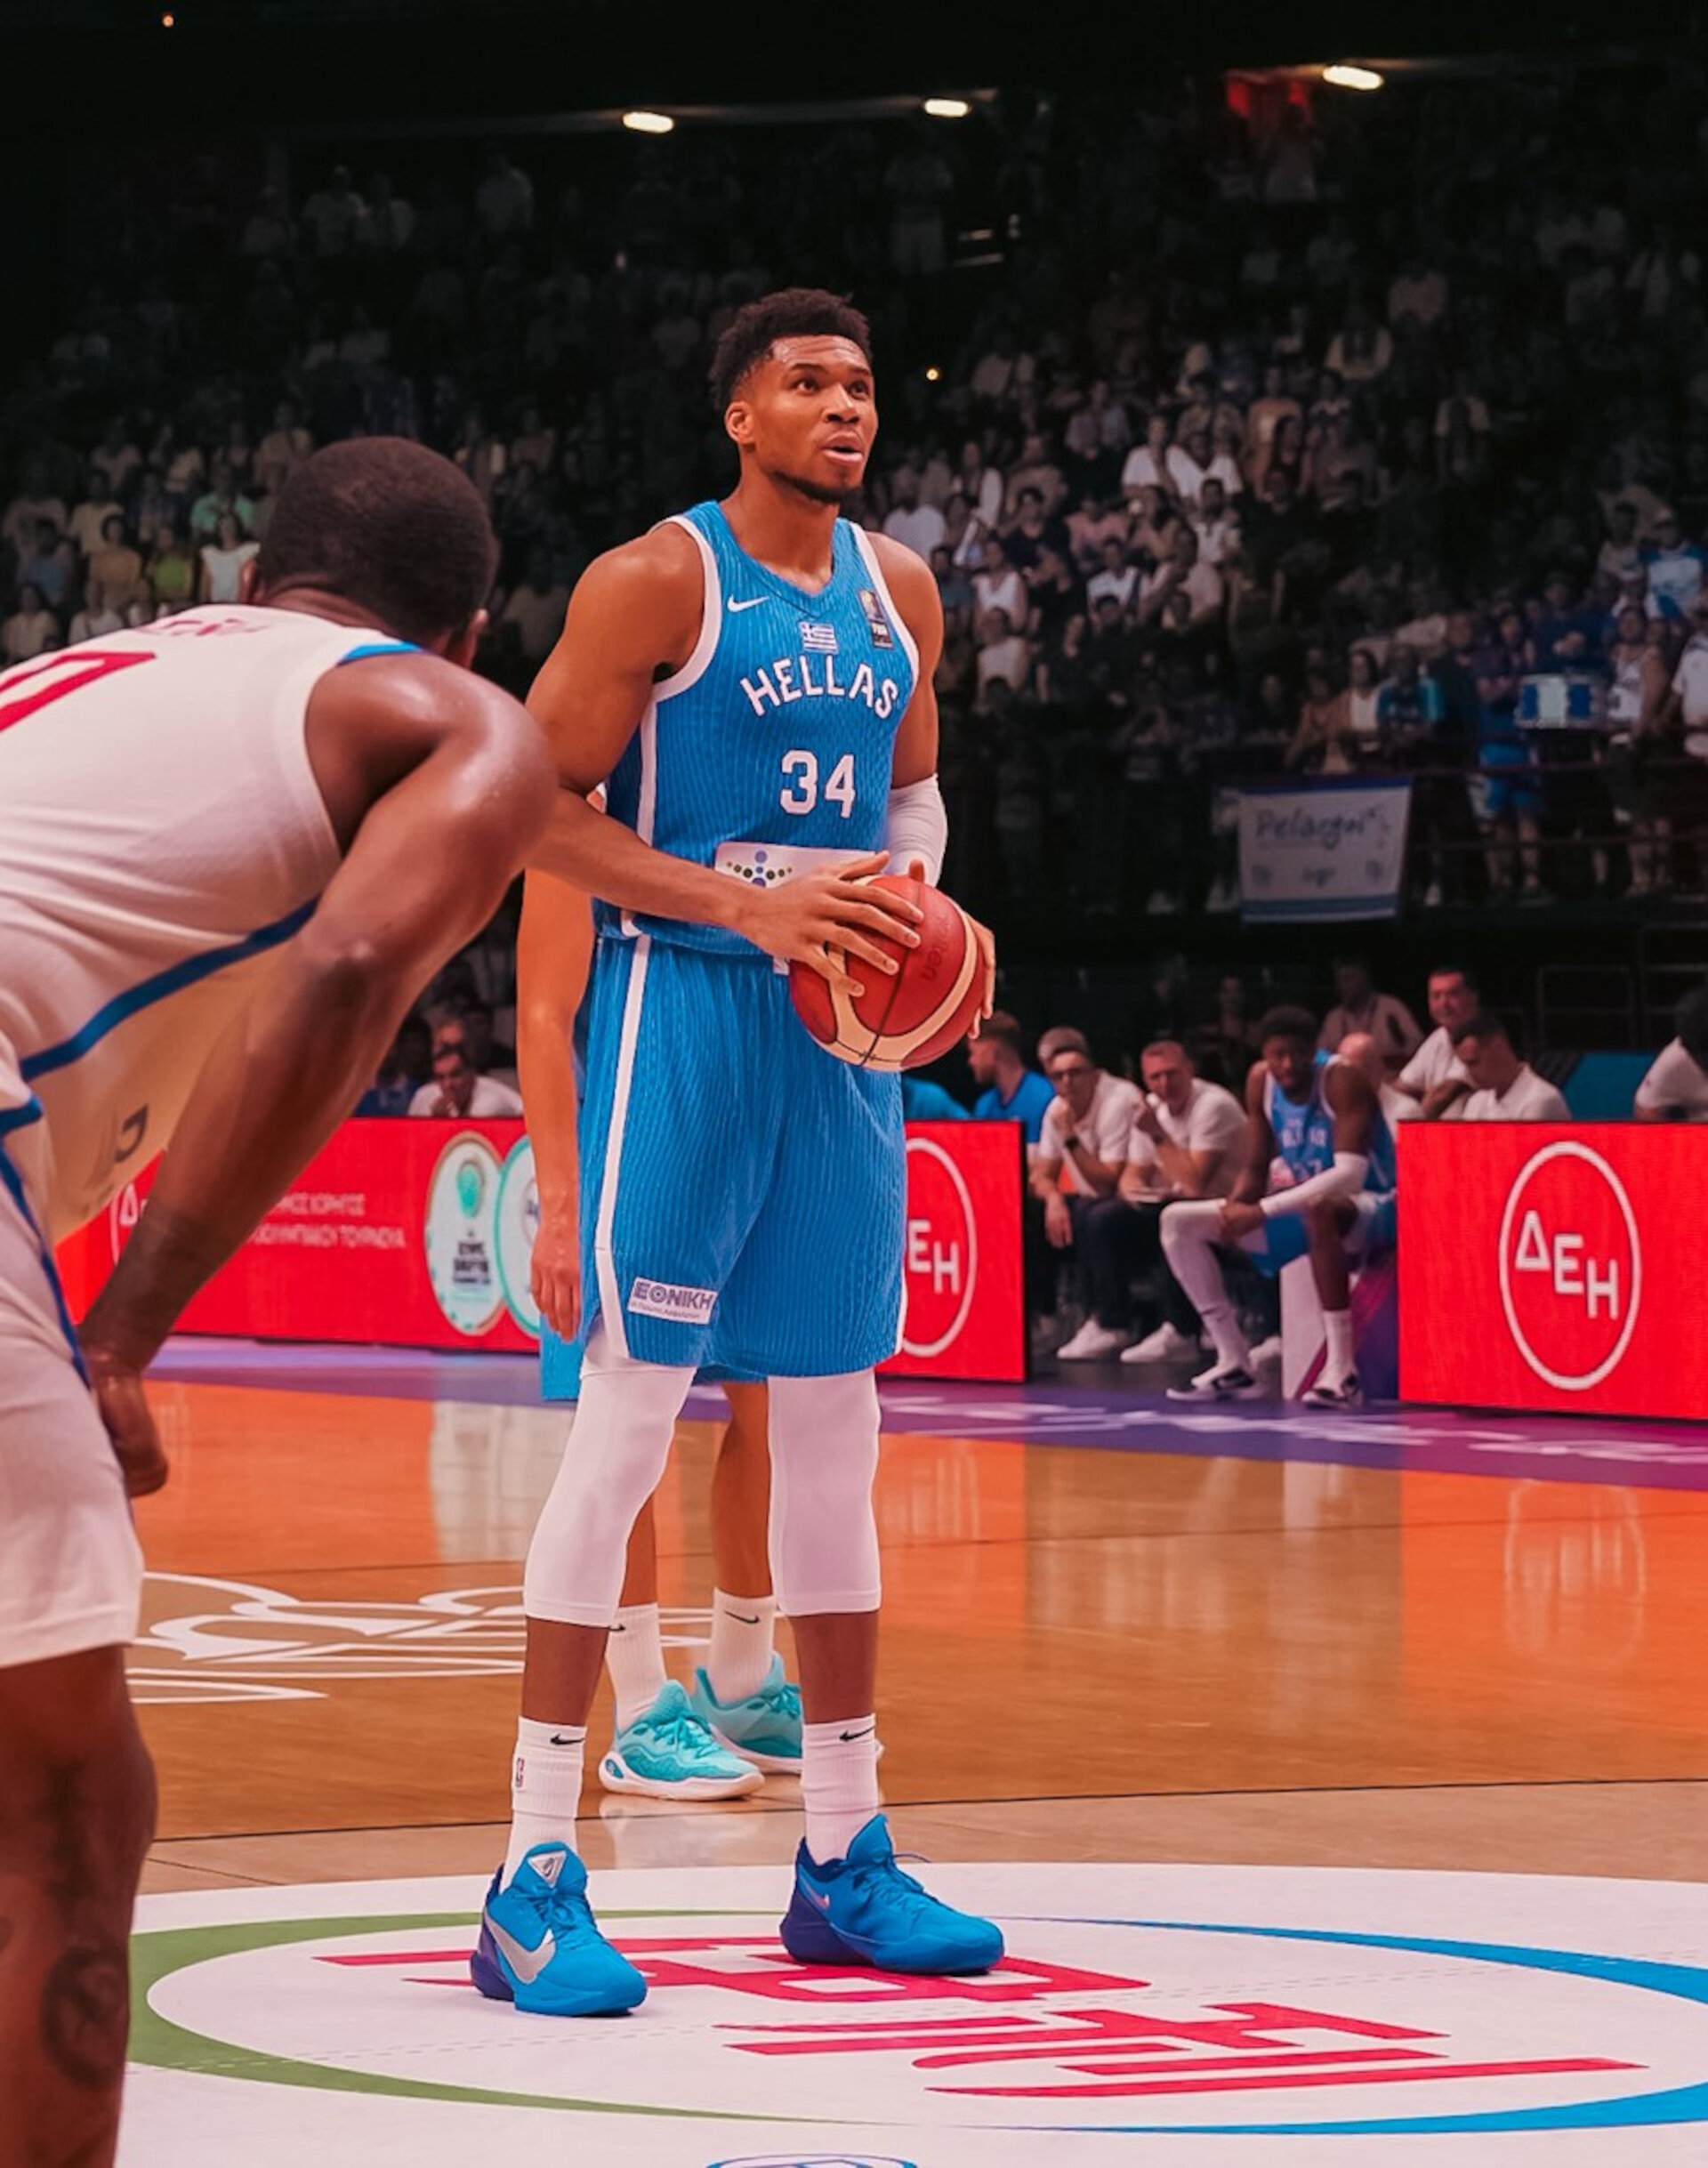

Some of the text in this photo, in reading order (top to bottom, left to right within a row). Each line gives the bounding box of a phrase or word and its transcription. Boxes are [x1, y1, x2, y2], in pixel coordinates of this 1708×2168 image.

[740, 655, 898, 720] HELLAS
[779, 749, 857, 819] 34
[907, 1219, 960, 1294] ΕΗ
[1514, 1210, 1619, 1320] ΔΕΗ
